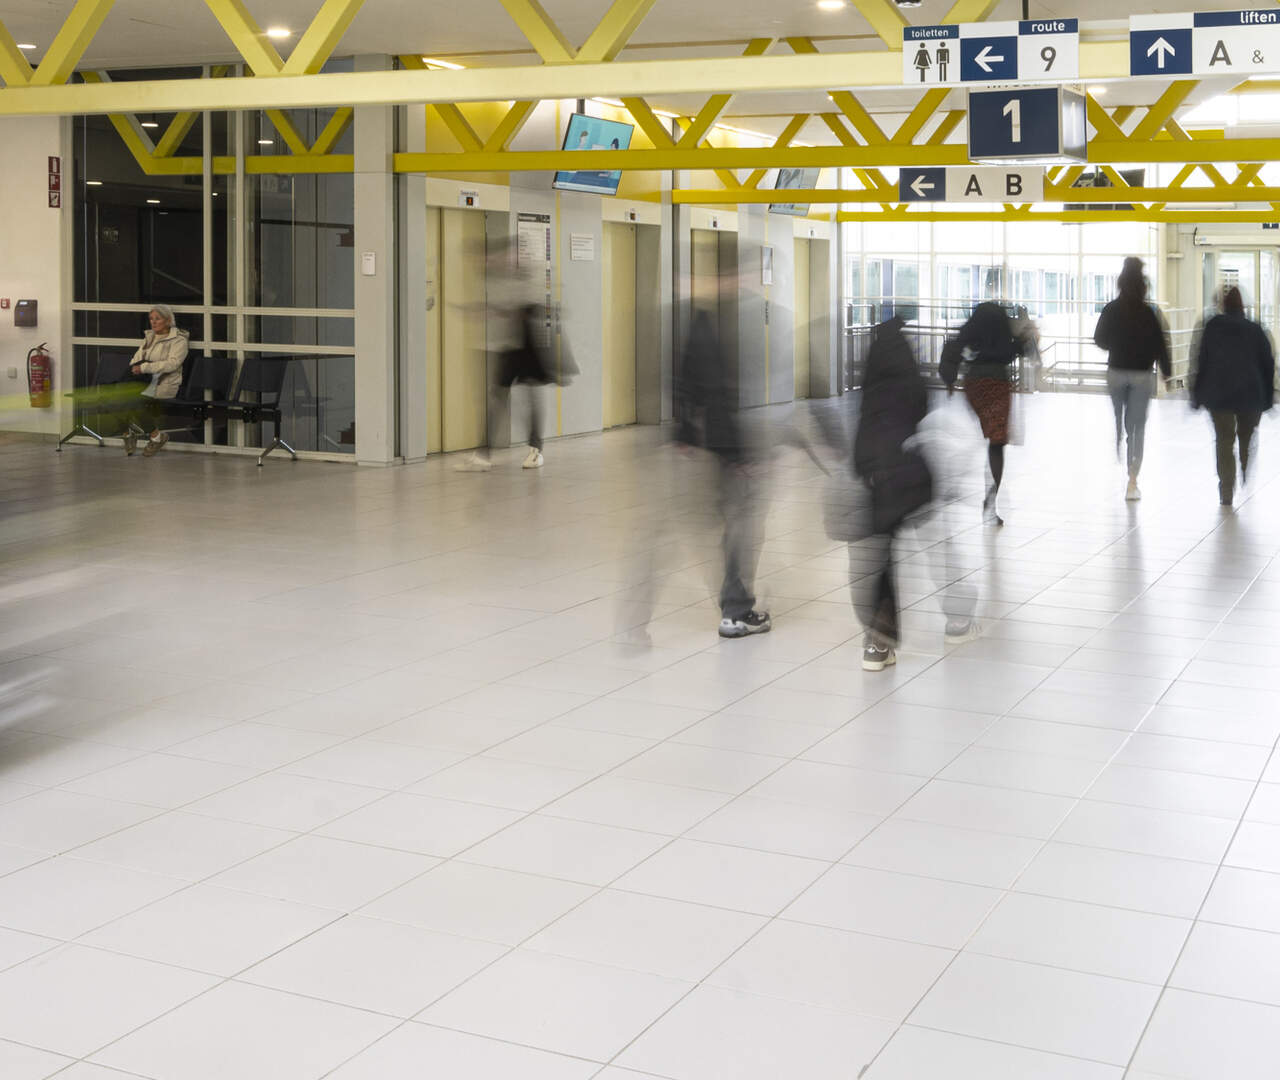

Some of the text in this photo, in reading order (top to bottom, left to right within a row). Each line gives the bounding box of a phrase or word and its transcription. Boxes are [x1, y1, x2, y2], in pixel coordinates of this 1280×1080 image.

[1031, 21, 1066, 33] route
[1240, 11, 1277, 24] liften
[911, 28, 949, 38] toiletten
[1040, 46, 1057, 72] 9
[1209, 40, 1232, 66] A
[1252, 49, 1265, 64] &
[1002, 99, 1021, 143] 1
[964, 173, 1023, 196] A B
